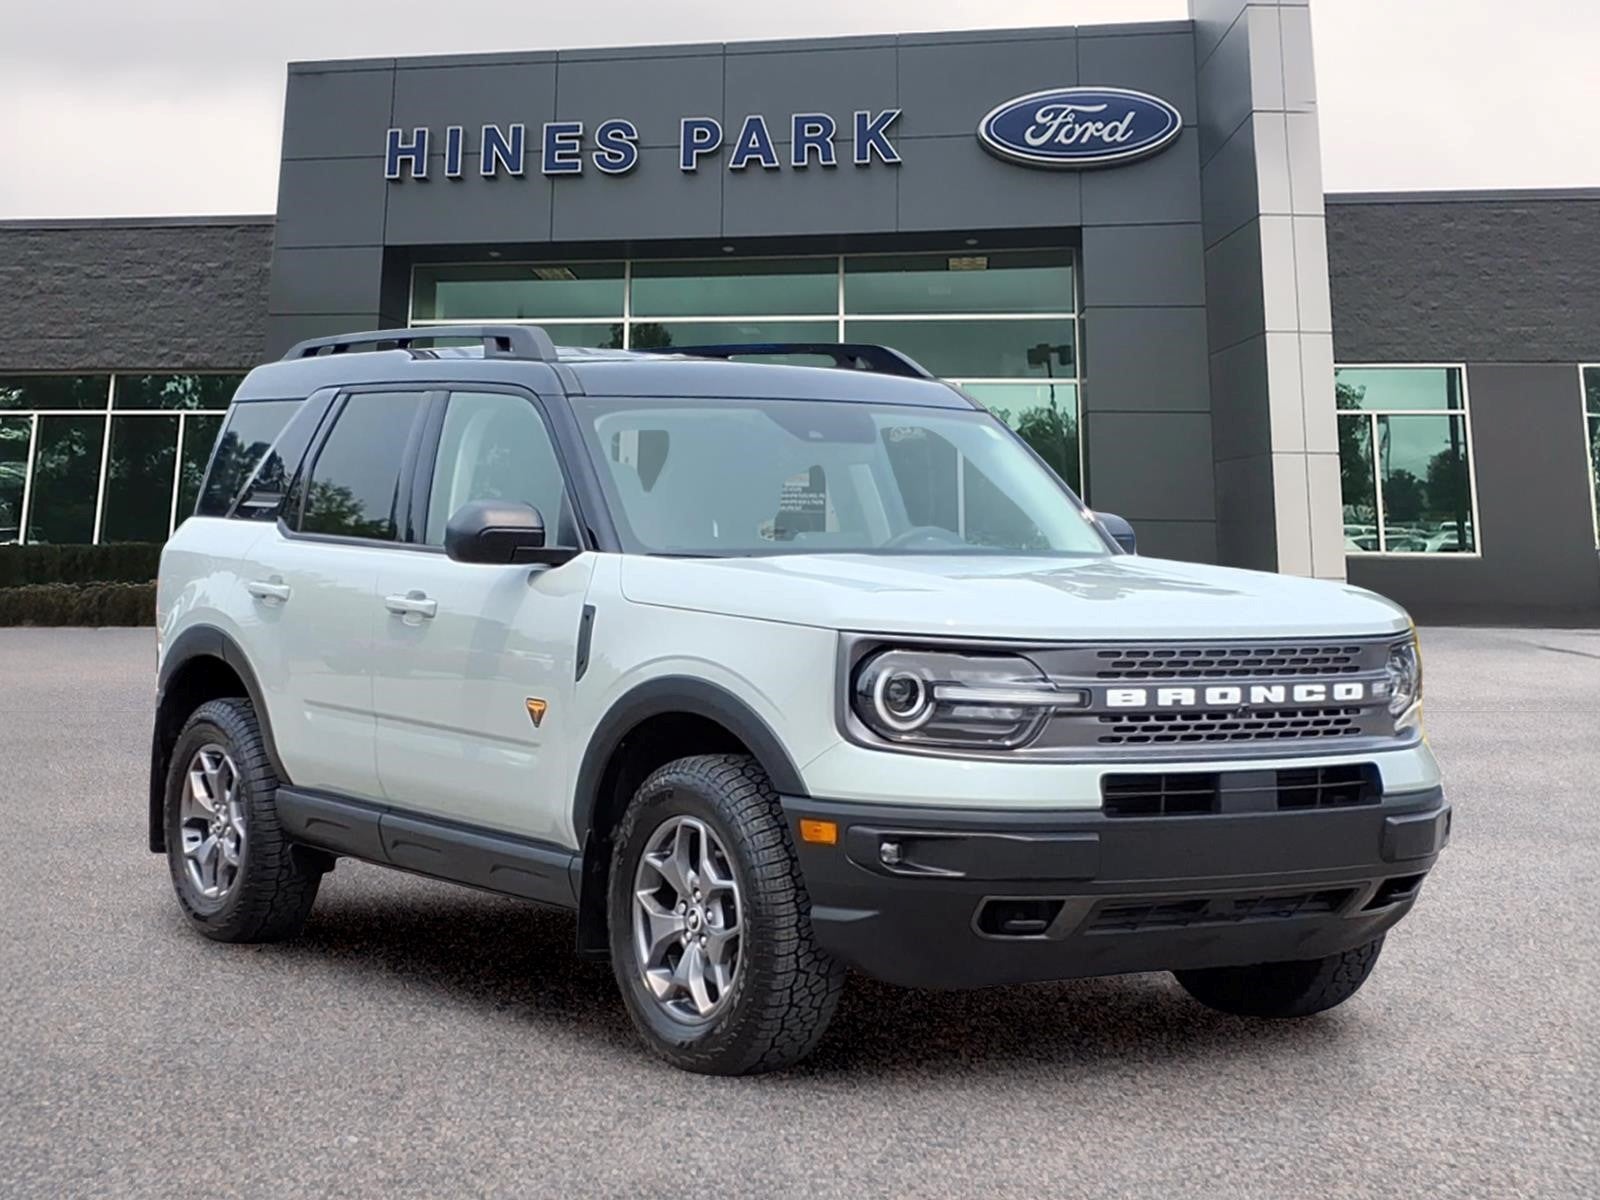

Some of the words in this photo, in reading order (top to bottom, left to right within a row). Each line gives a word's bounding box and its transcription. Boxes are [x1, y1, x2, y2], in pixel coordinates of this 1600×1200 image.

[384, 118, 639, 179] HINES
[679, 109, 903, 171] PARK
[1024, 103, 1136, 147] Ford
[1106, 682, 1364, 707] BRONCO
